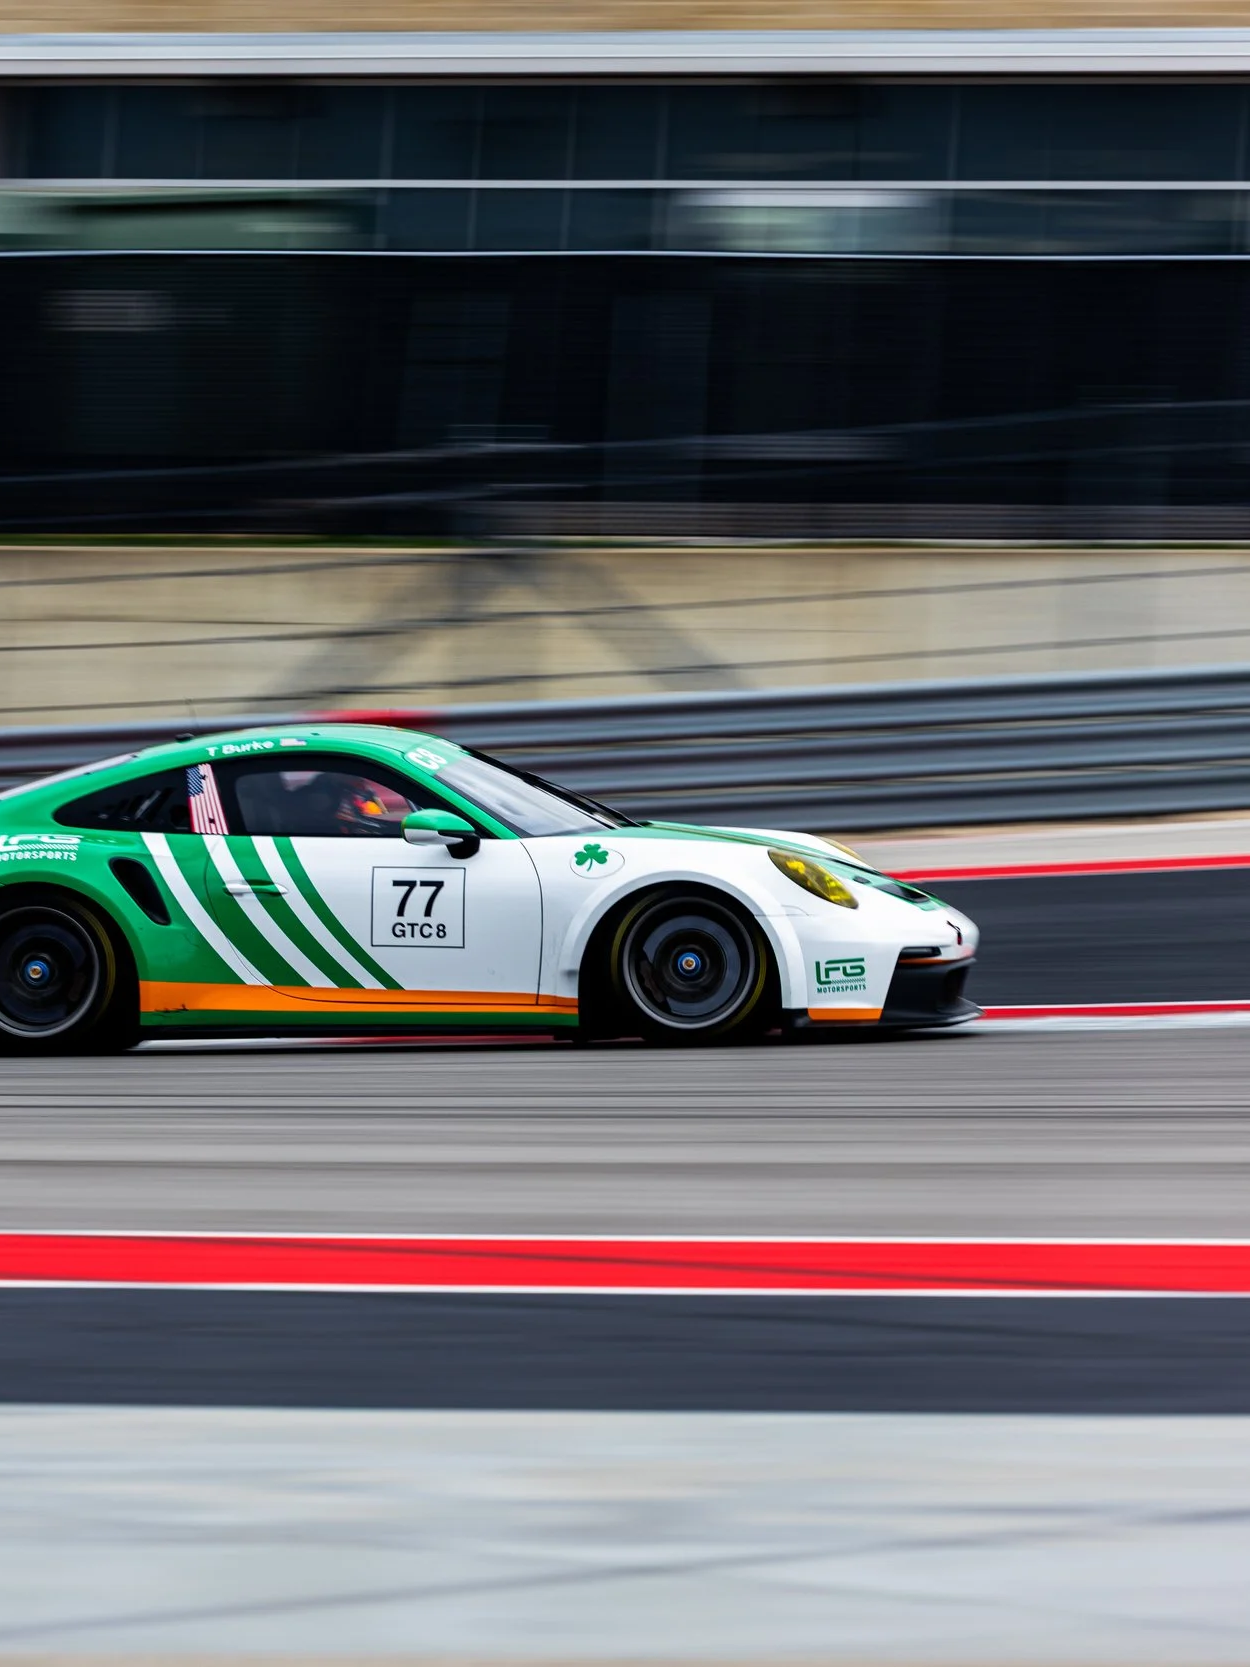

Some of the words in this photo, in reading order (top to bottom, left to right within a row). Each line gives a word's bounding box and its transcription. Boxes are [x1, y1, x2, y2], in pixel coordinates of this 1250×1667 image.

[206, 747, 219, 756] T
[222, 740, 275, 755] Burke
[407, 747, 448, 770] C8
[392, 880, 445, 917] 77
[815, 957, 865, 985] LFG
[817, 984, 866, 993] MOTORSPORTS
